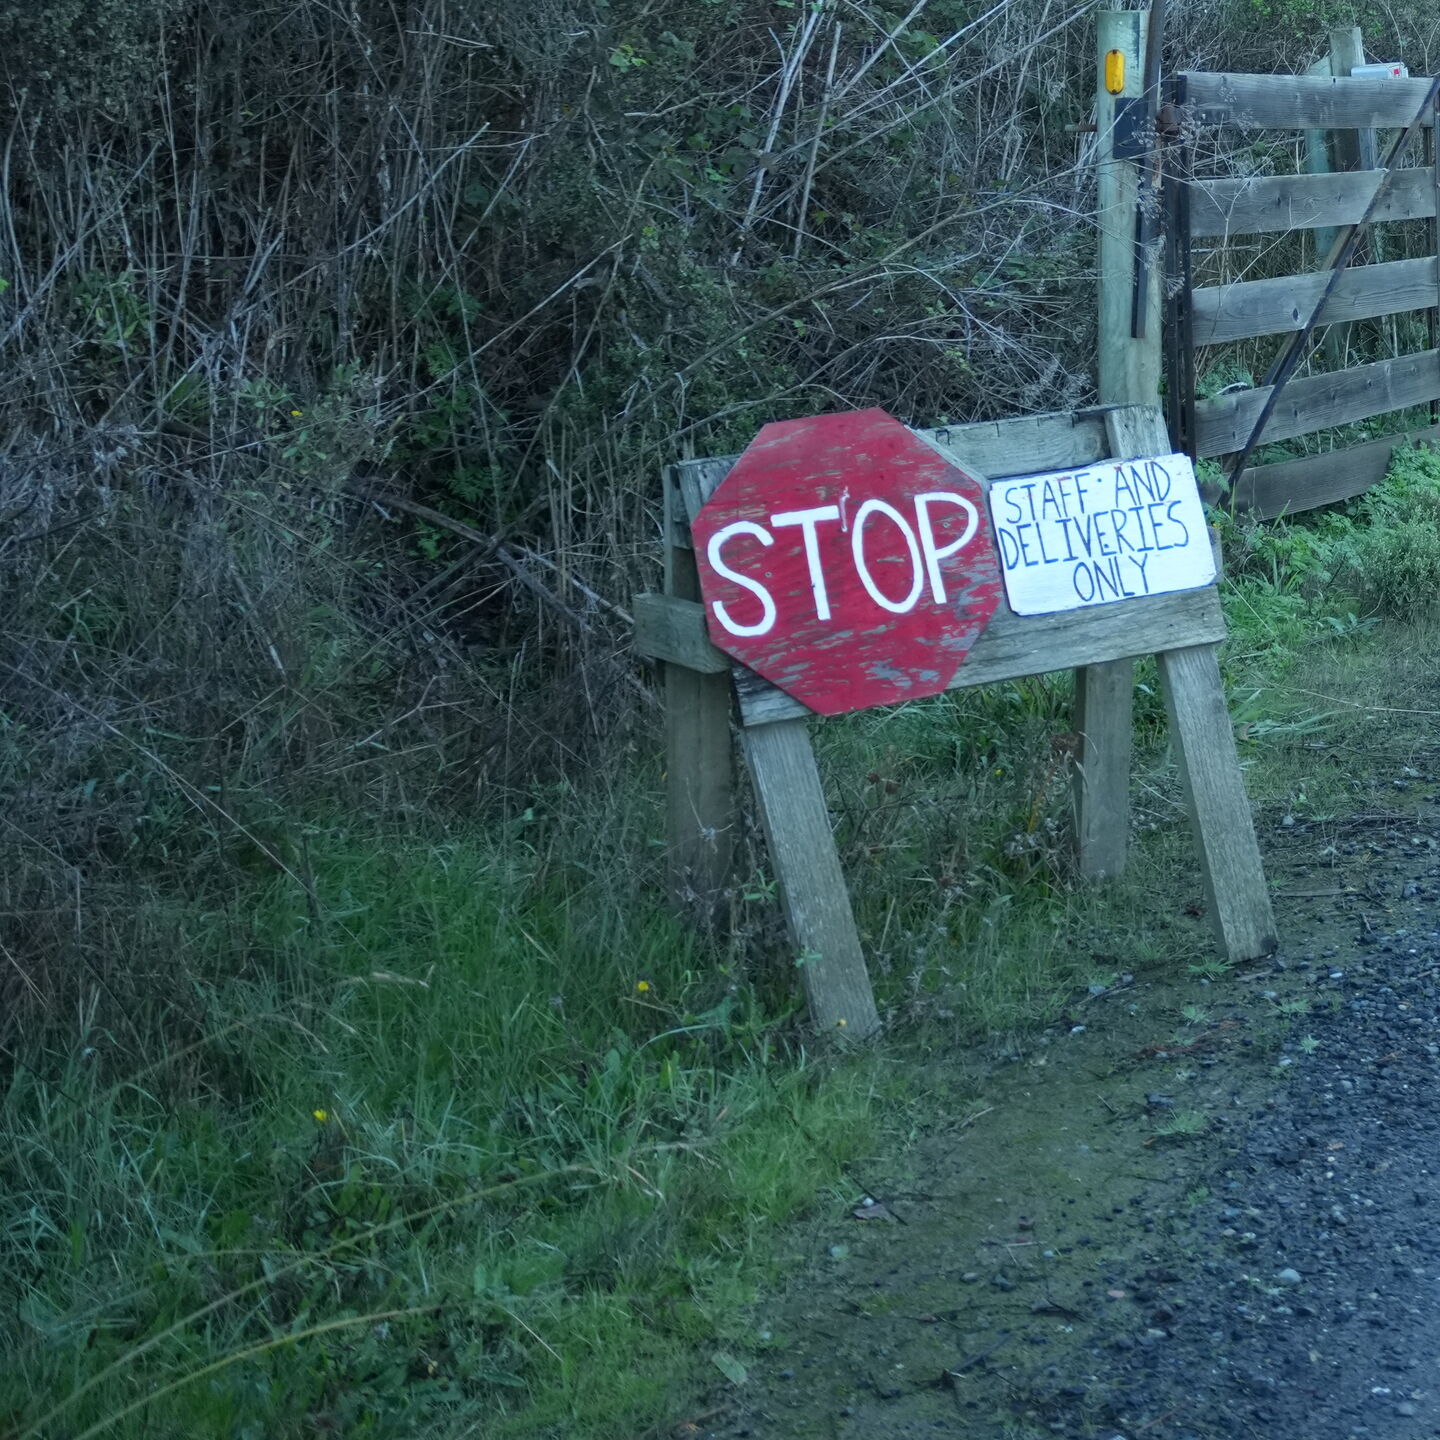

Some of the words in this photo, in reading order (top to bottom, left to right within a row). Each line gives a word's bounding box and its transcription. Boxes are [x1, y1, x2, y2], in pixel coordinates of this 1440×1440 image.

[1004, 472, 1090, 525] STAFF
[1114, 464, 1172, 506] AND
[707, 491, 979, 637] STOP
[999, 499, 1190, 571] DELIVERIES
[1073, 556, 1152, 603] ONLY
